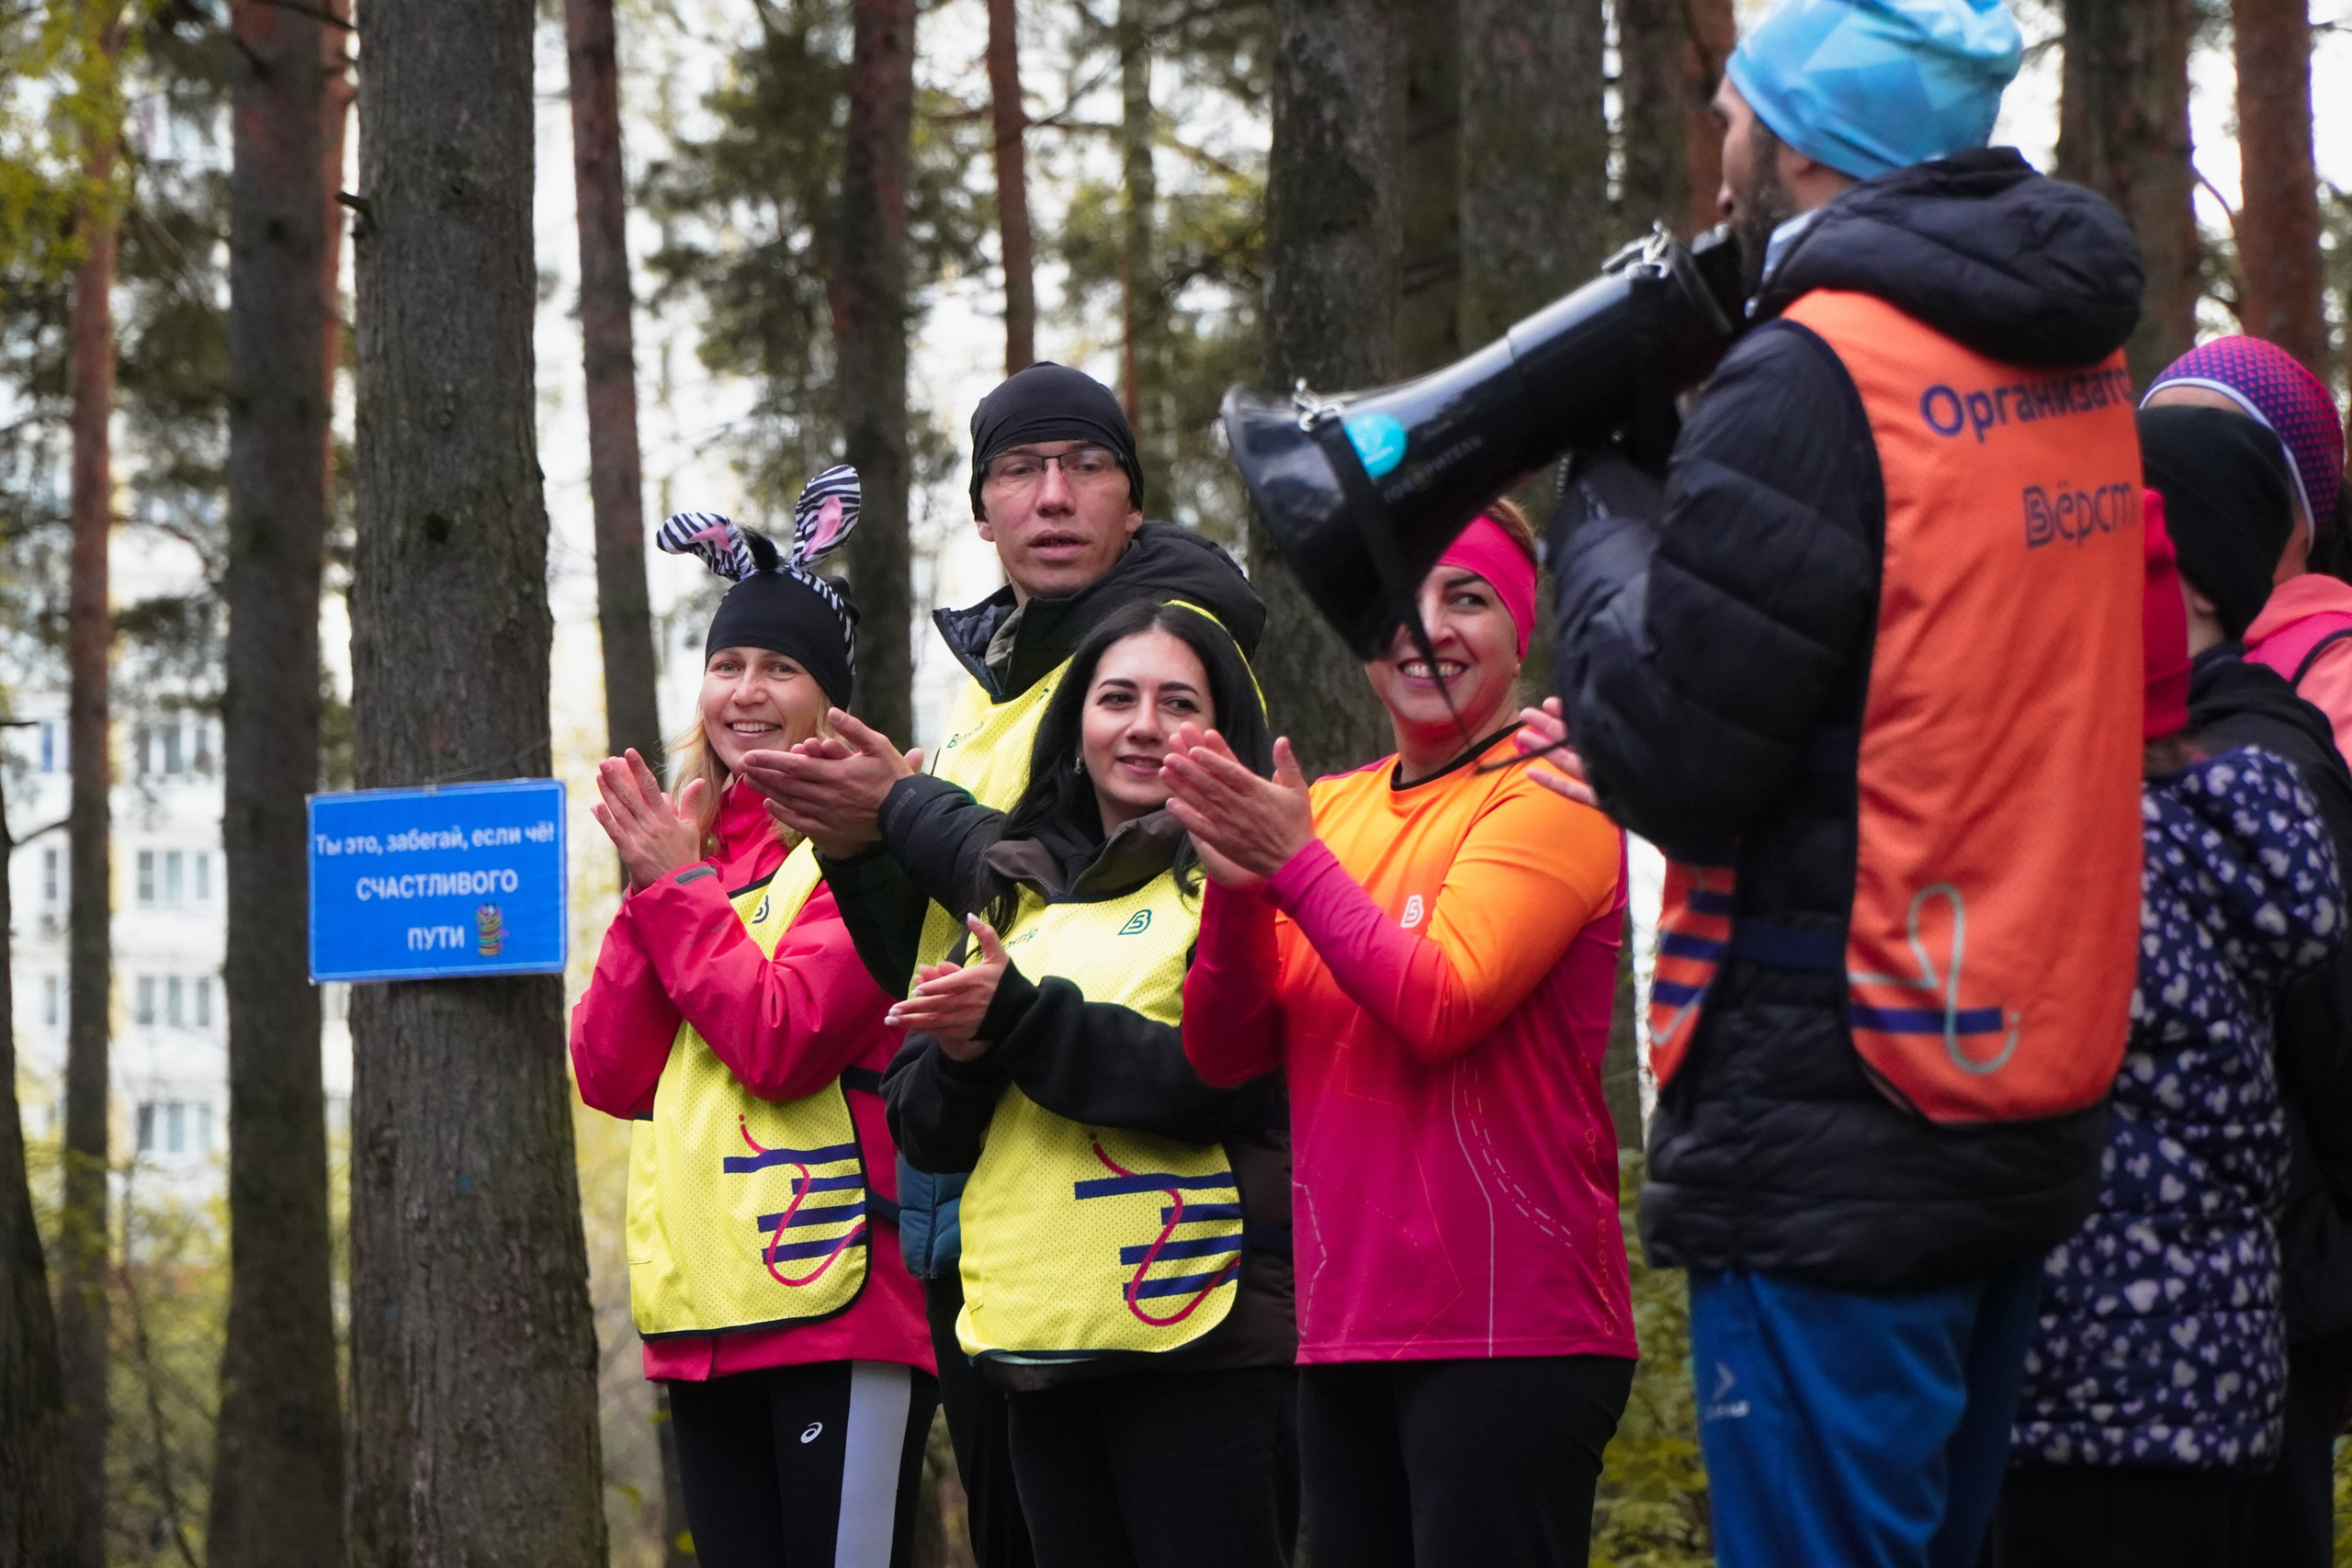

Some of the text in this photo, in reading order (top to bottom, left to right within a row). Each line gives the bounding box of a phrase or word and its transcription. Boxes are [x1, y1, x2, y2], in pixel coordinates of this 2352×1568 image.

[315, 820, 555, 857] Ты это, забегай, если чё!
[356, 868, 518, 901] СЧАСТЛИВОГО
[407, 925, 465, 952] ПУТИ
